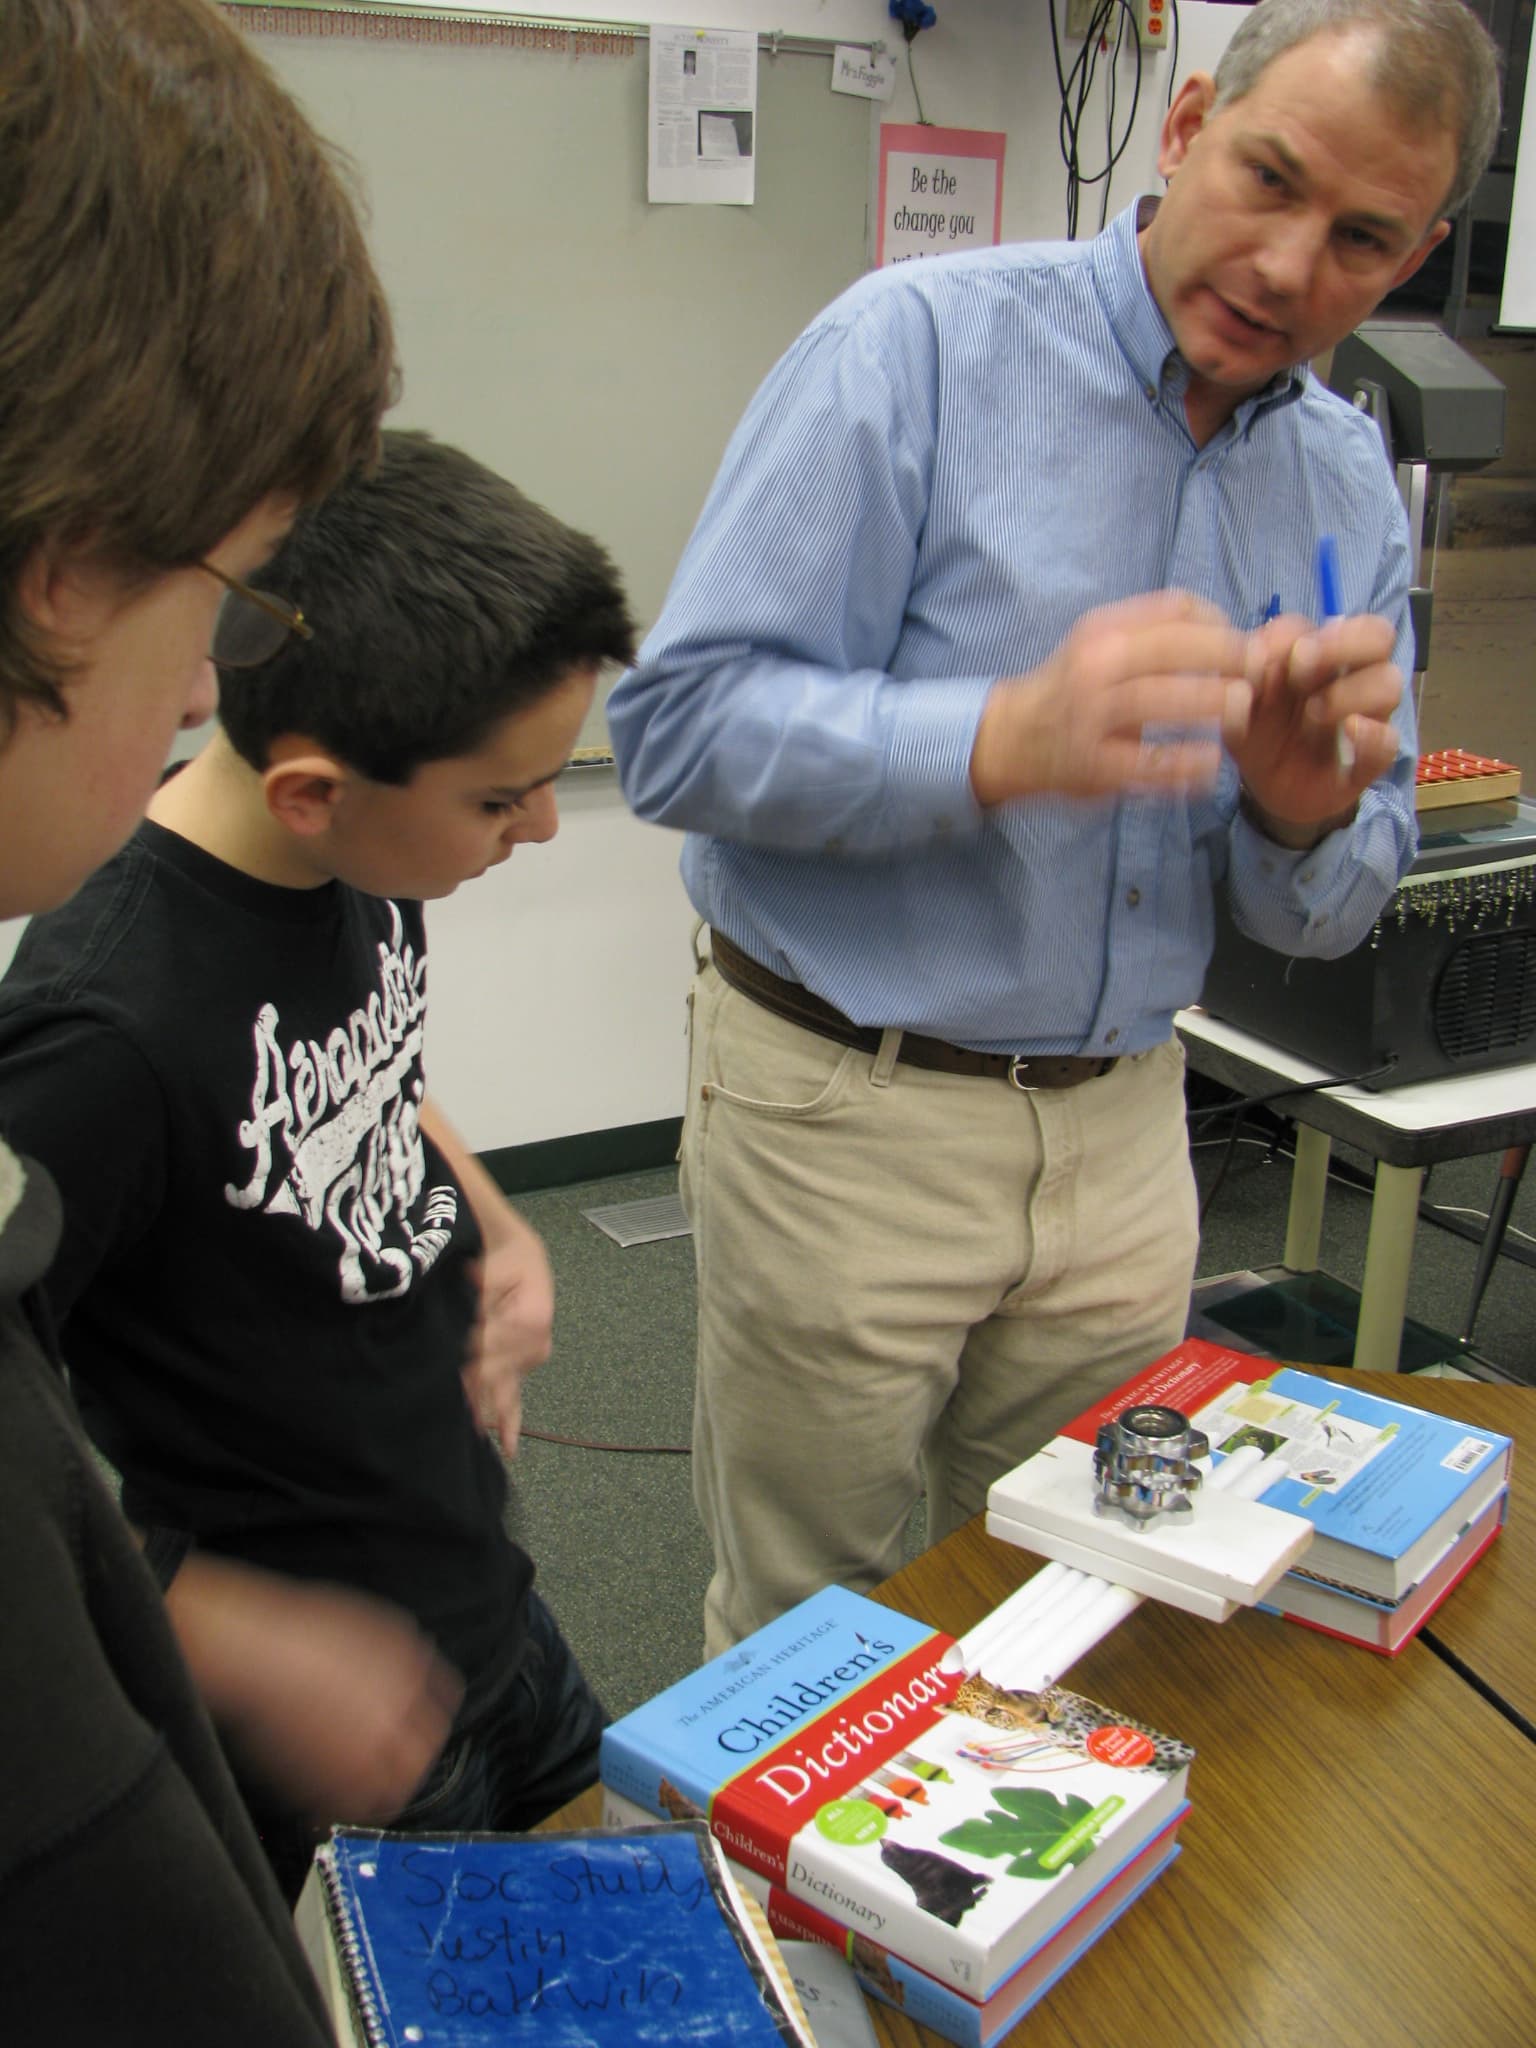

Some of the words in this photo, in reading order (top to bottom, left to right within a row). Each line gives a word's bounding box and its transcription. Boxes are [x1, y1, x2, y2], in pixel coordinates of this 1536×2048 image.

[911, 167, 927, 193] Be
[933, 168, 957, 195] the
[894, 205, 945, 239] change
[949, 215, 975, 240] you
[1153, 1361, 1203, 1393] Dictionary
[700, 1664, 771, 1715] AMERICAN
[769, 1617, 840, 1665] HERITAGE
[717, 1632, 896, 1755] Children's
[755, 1661, 948, 1807] Dictionar
[713, 1820, 785, 1873] Children's
[791, 1861, 887, 1931] Dictionary
